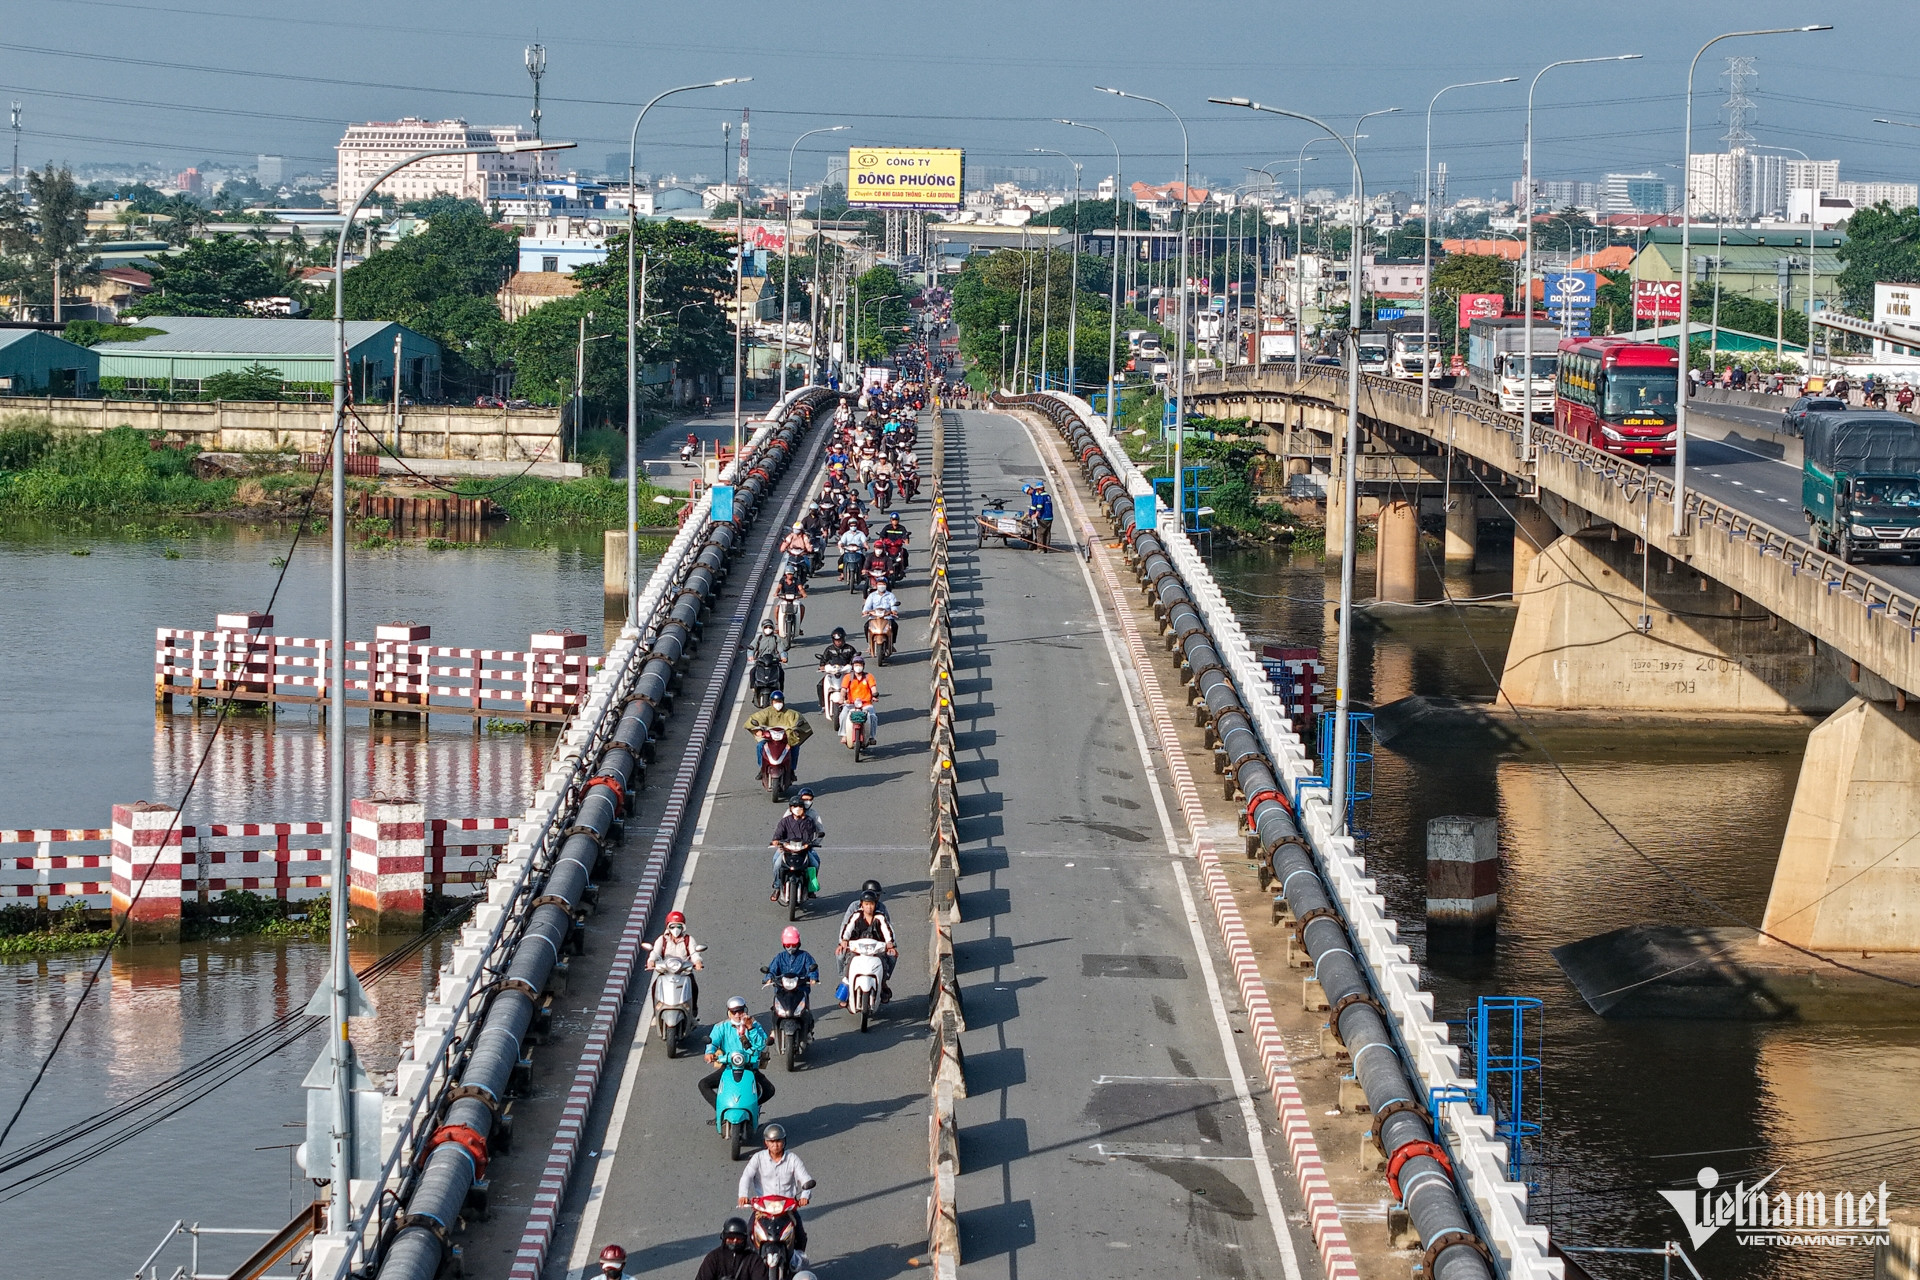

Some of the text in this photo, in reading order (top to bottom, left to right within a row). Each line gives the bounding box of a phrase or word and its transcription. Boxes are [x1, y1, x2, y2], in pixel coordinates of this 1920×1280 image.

[886, 156, 931, 167] CÔNG TY
[899, 173, 956, 187] PHƯƠNG
[1638, 282, 1681, 298] JAC
[1659, 662, 1684, 671] 1979
